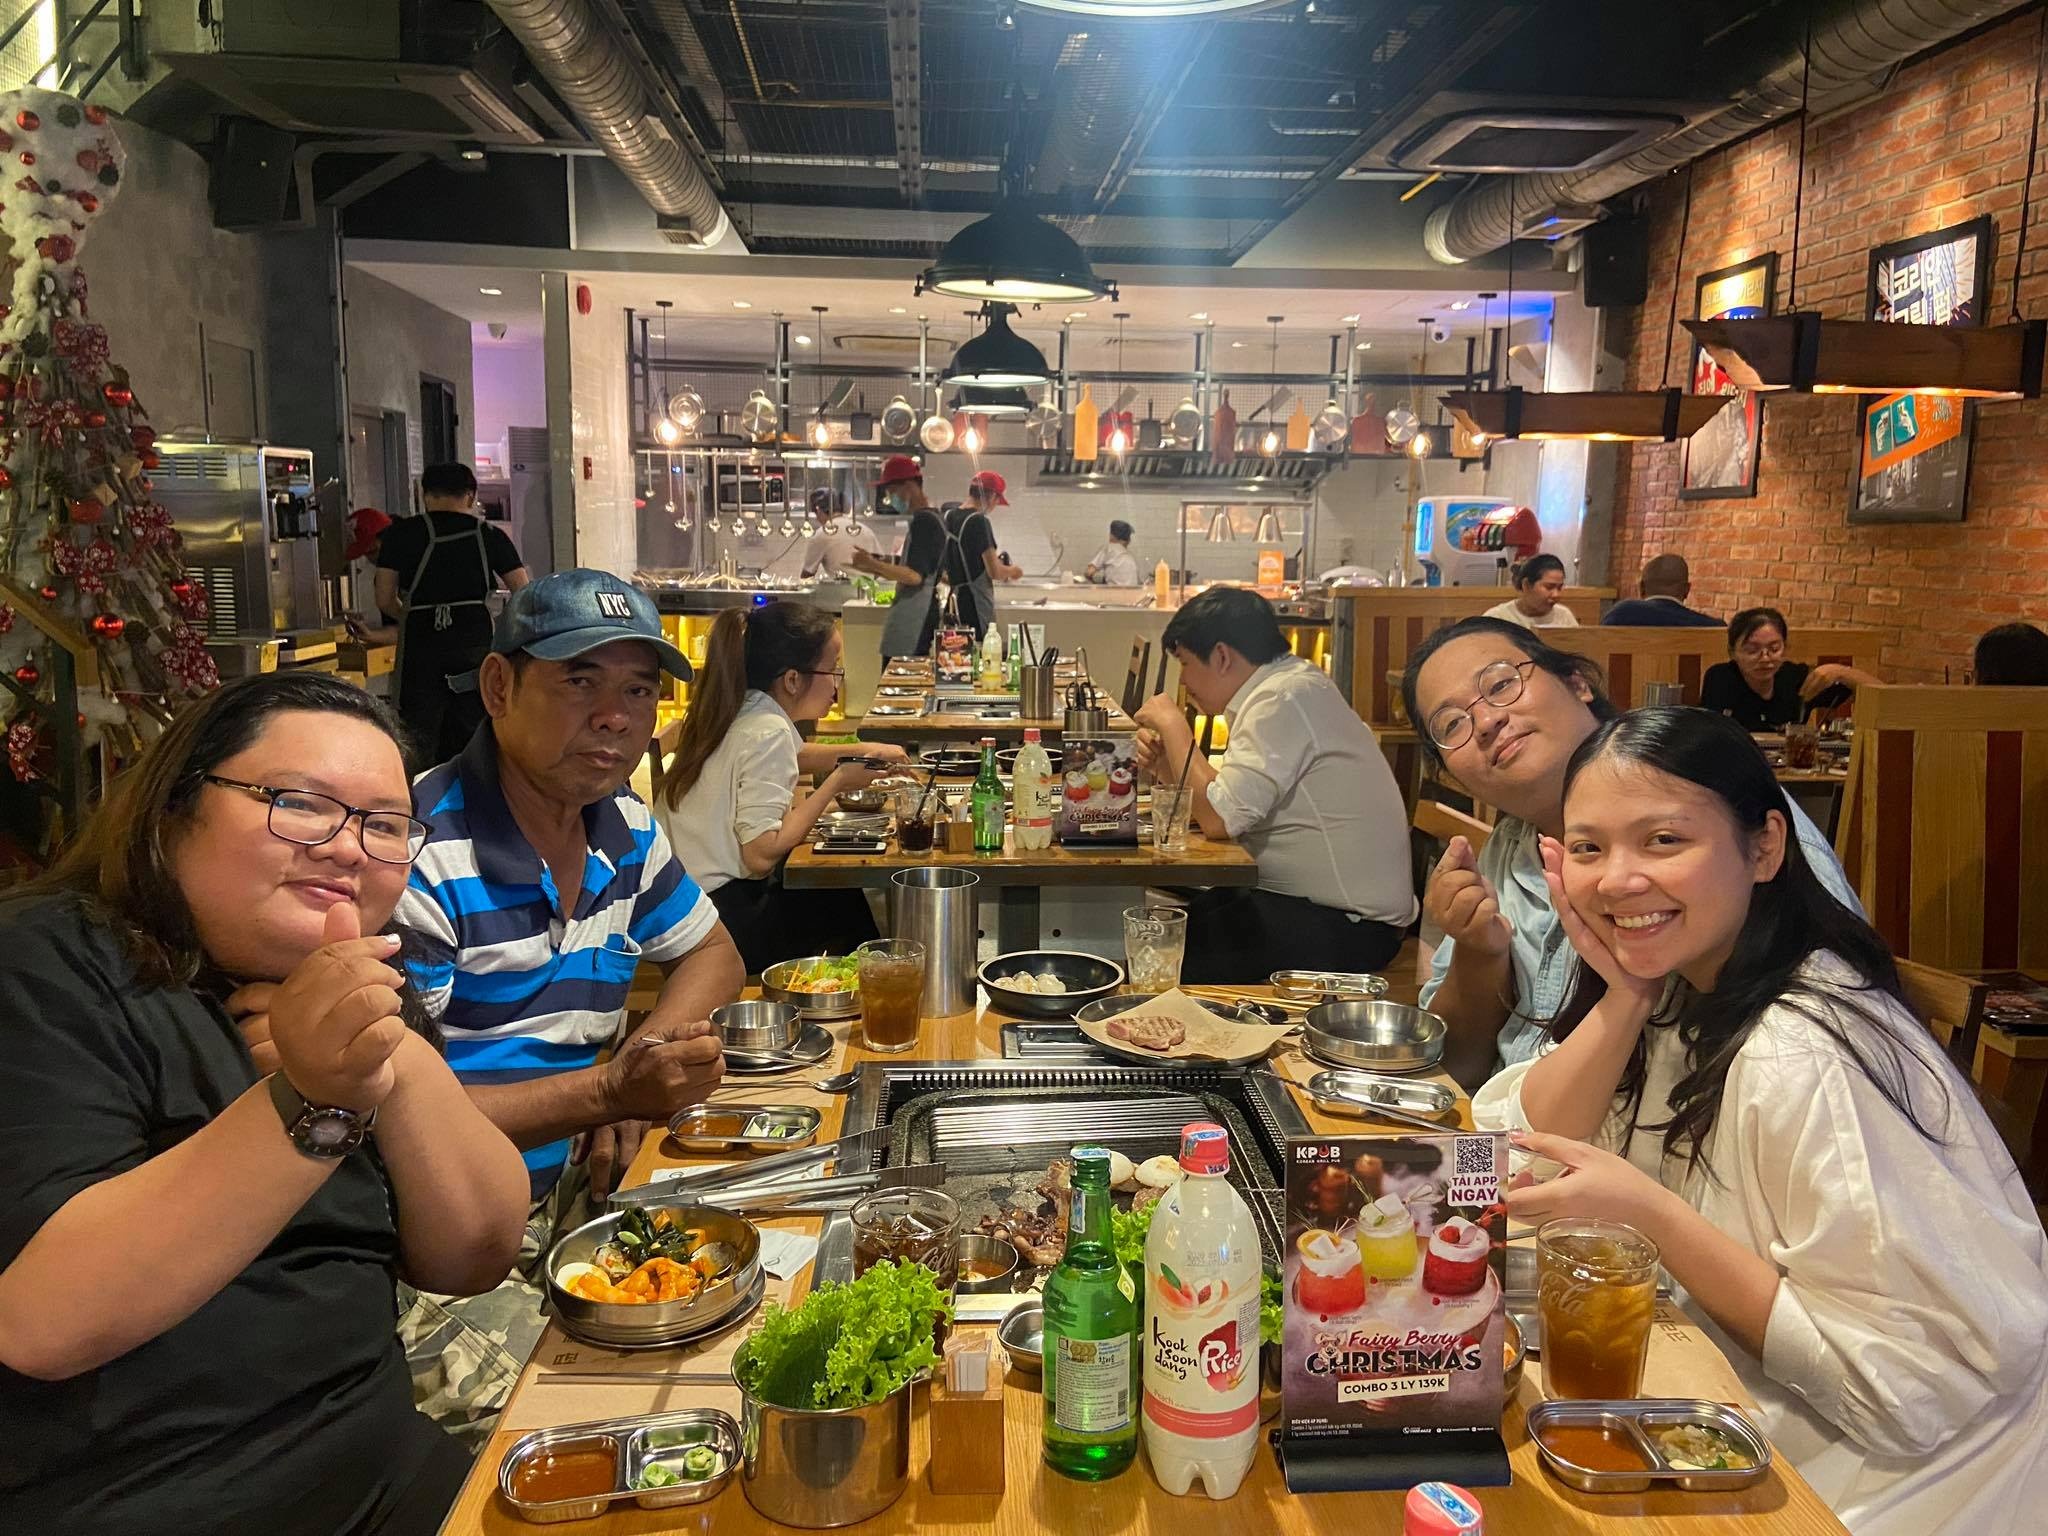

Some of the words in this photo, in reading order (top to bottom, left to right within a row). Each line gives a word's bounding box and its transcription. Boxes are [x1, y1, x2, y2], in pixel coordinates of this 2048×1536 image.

[597, 593, 631, 616] NYC
[1474, 1176, 1498, 1186] APP
[1452, 1188, 1497, 1202] NGAY
[1348, 1330, 1400, 1350] Fairy
[1405, 1330, 1461, 1350] Berry
[1155, 1349, 1187, 1380] dang
[1200, 1340, 1242, 1378] Rice
[1305, 1349, 1482, 1375] CHRISTMAS
[1344, 1382, 1388, 1394] COMBO
[1391, 1382, 1398, 1390] 3
[1401, 1380, 1415, 1389] LY
[1419, 1378, 1445, 1388] 139K
